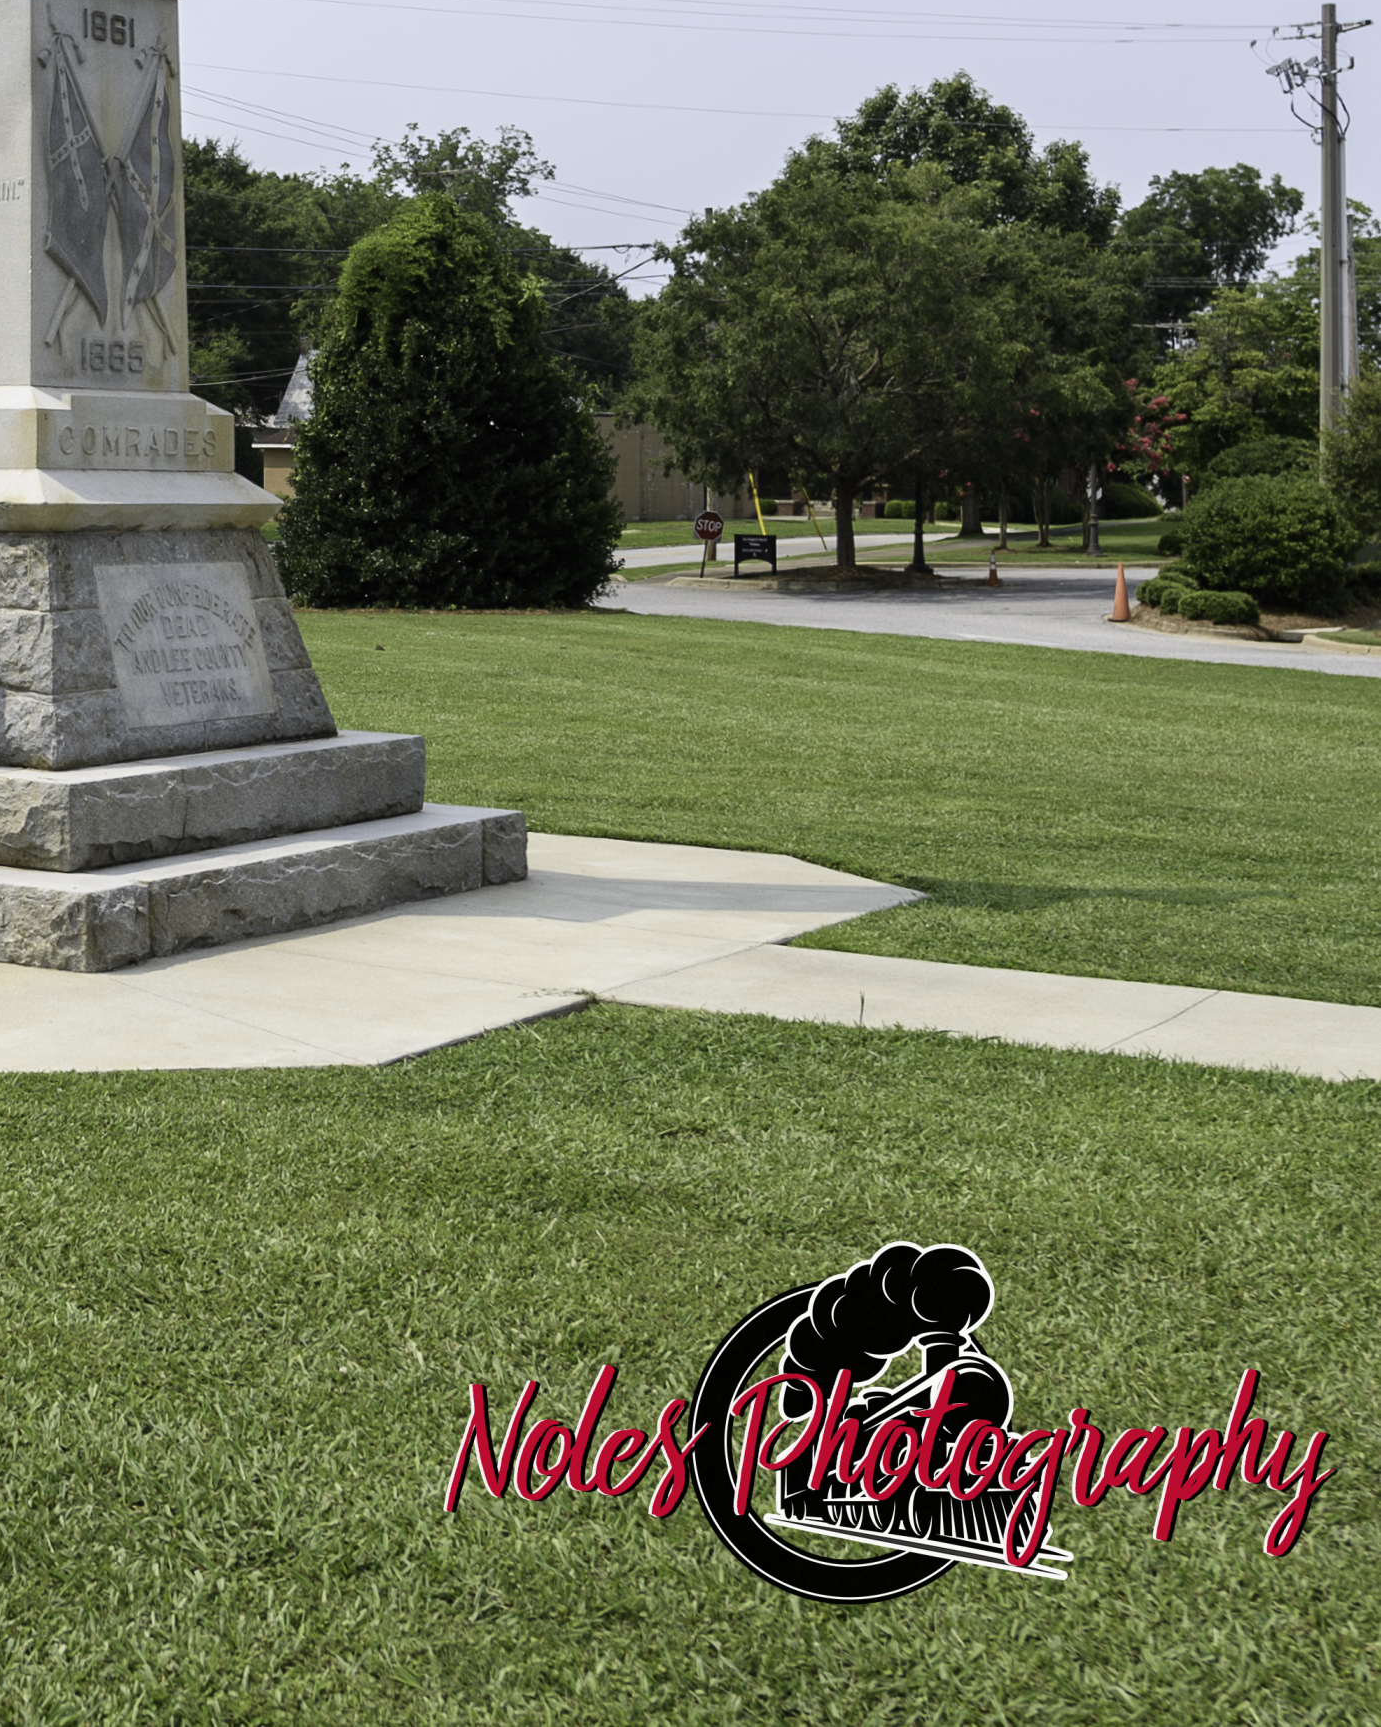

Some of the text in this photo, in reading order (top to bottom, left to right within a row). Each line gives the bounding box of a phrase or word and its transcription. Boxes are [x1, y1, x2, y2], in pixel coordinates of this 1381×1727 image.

[83, 7, 135, 48] 1861
[81, 337, 144, 373] 1865
[59, 425, 217, 457] COMRADES
[696, 518, 722, 533] STOP
[114, 583, 256, 653] TO OUR CONFEDERATE
[160, 614, 210, 639] DEAD
[133, 643, 248, 675] AND LEE COUNTY
[160, 678, 242, 707] VETERANS.
